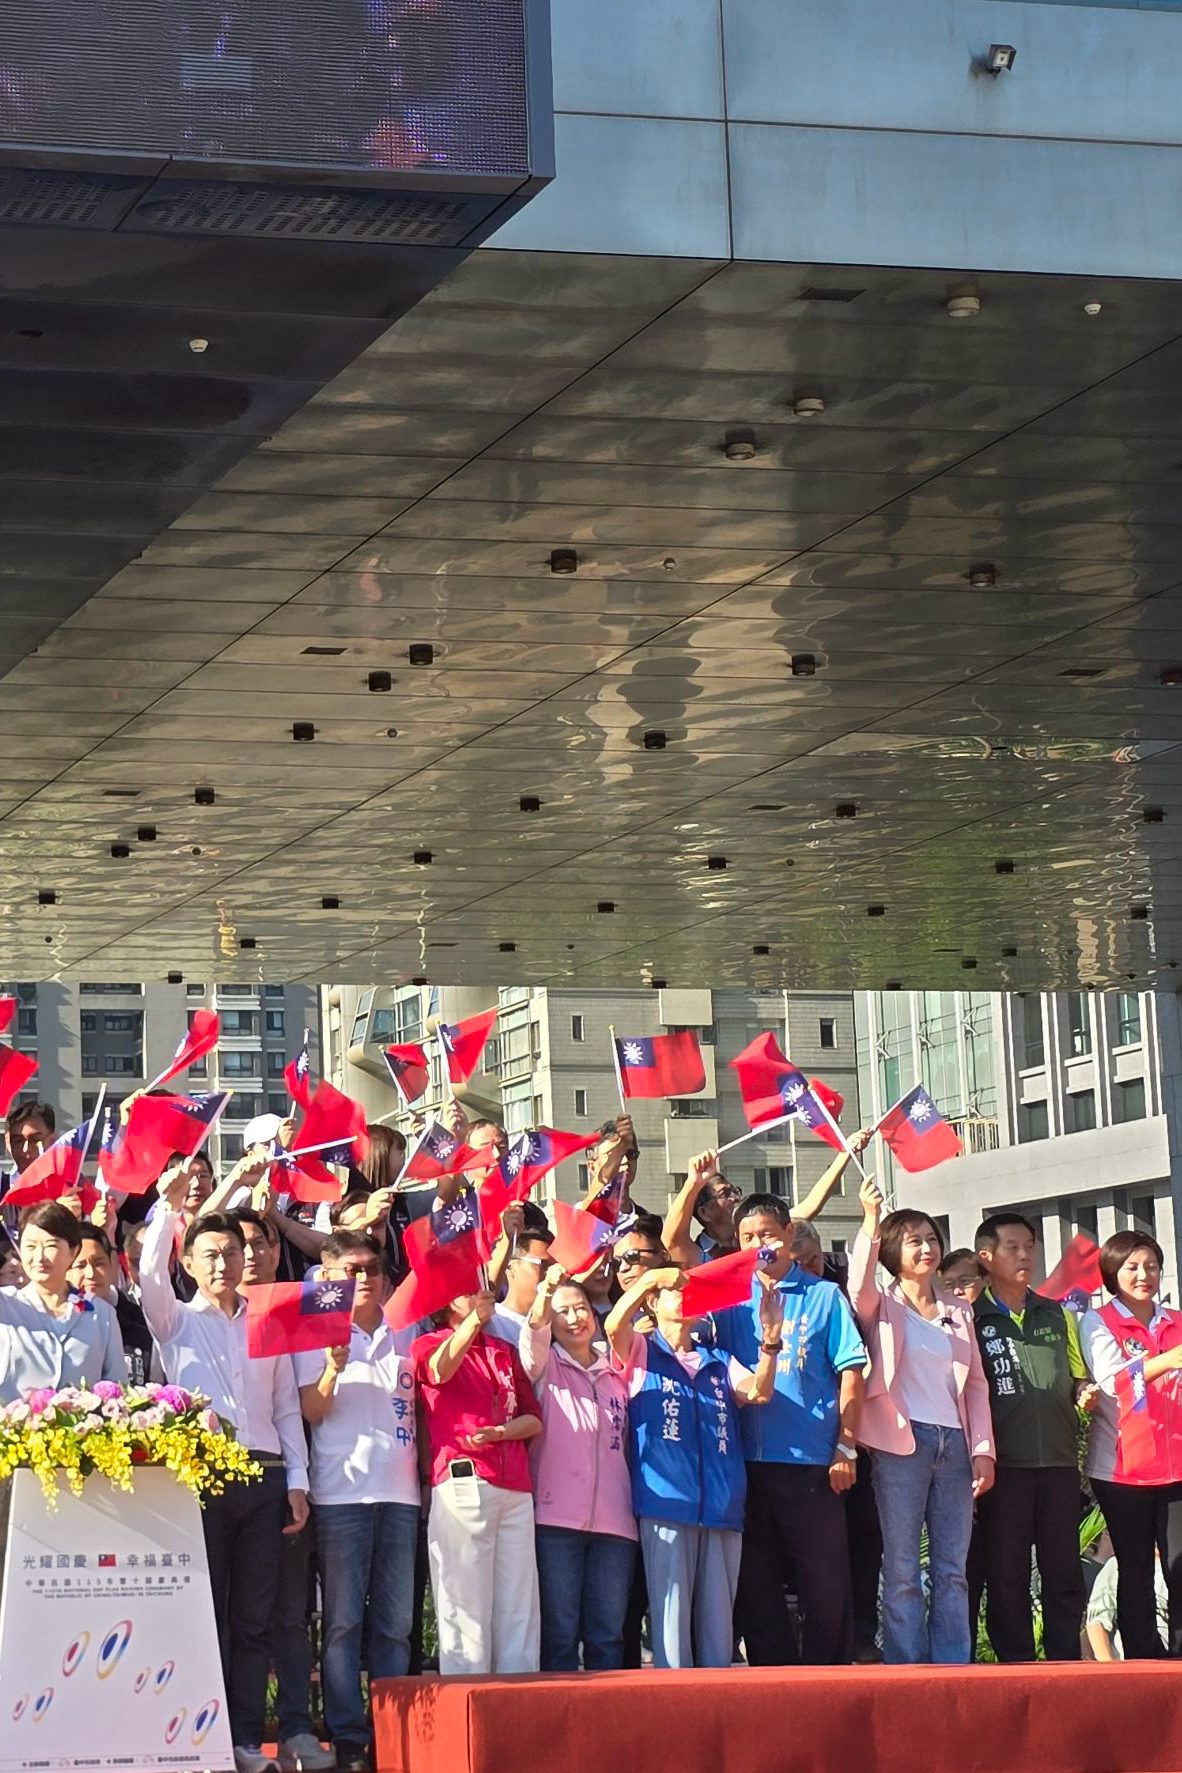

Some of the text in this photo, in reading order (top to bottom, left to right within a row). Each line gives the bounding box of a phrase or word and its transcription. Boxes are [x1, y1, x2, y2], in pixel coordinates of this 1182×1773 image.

[985, 1338, 1016, 1396] 鄭功進
[661, 1375, 682, 1442] 沈佑蓮
[22, 1552, 192, 1570] 光耀國慶 幸福臺中
